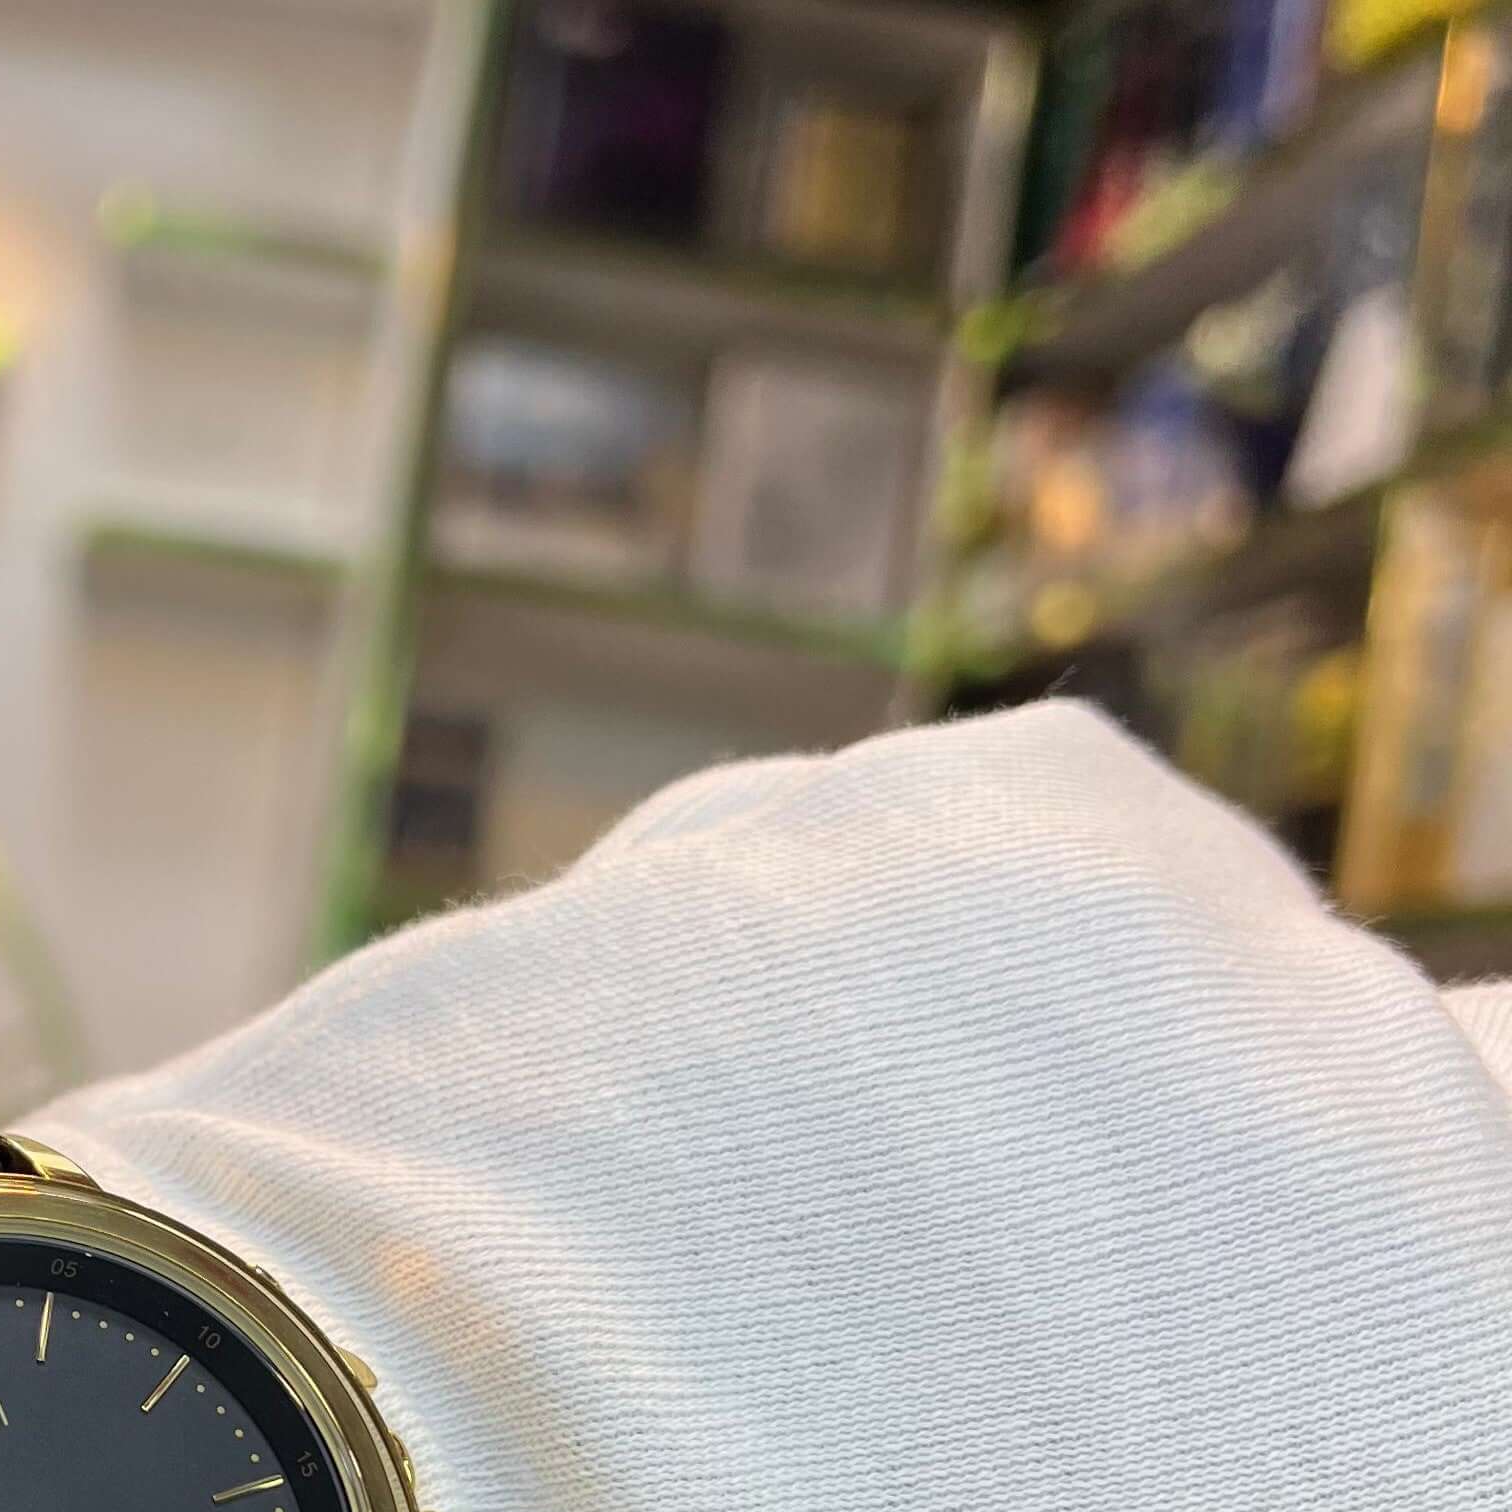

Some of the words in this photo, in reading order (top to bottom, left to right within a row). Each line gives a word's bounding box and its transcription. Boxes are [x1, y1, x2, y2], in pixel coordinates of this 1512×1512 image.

[51, 1258, 78, 1278] 05
[197, 1325, 222, 1349] 10
[297, 1450, 319, 1478] 15
